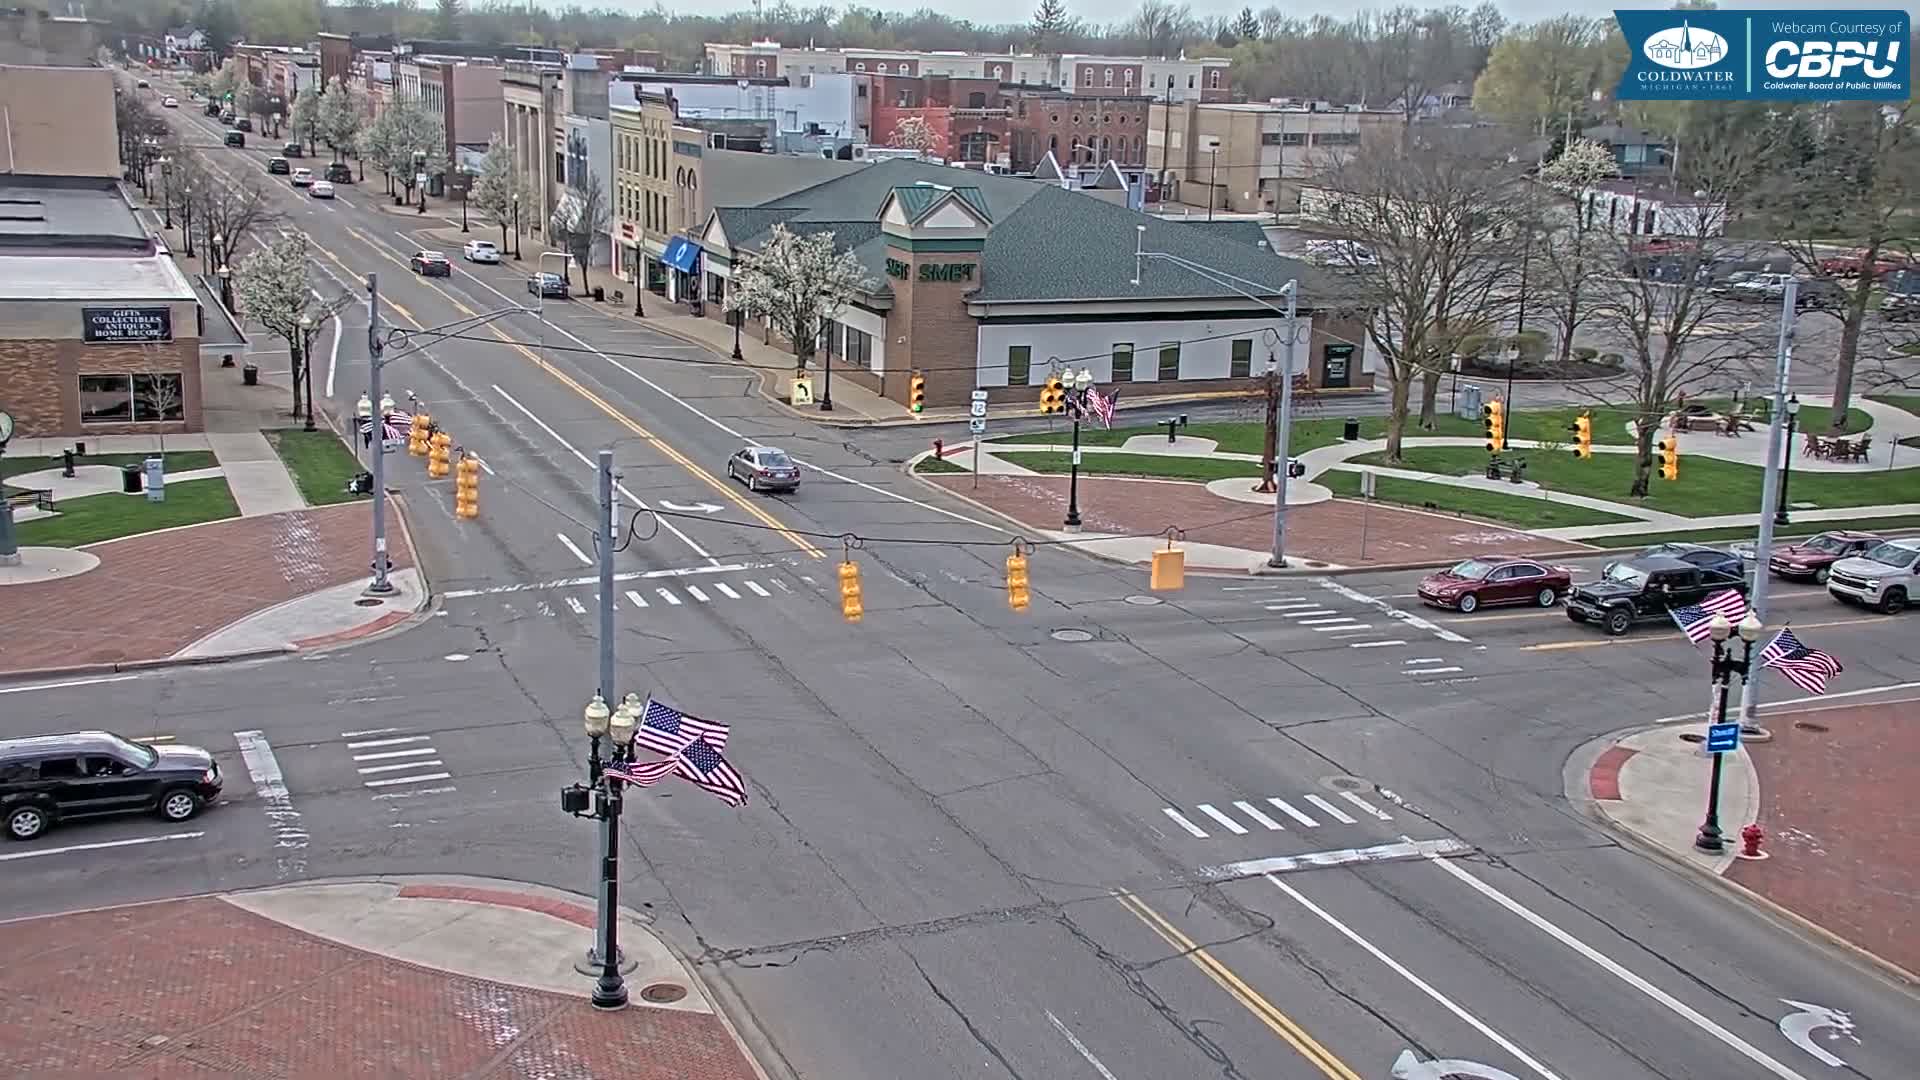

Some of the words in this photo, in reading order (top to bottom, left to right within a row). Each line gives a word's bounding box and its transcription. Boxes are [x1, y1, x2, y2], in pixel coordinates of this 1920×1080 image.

[113, 309, 140, 317] GIFTS
[92, 316, 162, 324] COLLECTIBLES
[974, 403, 984, 413] 12
